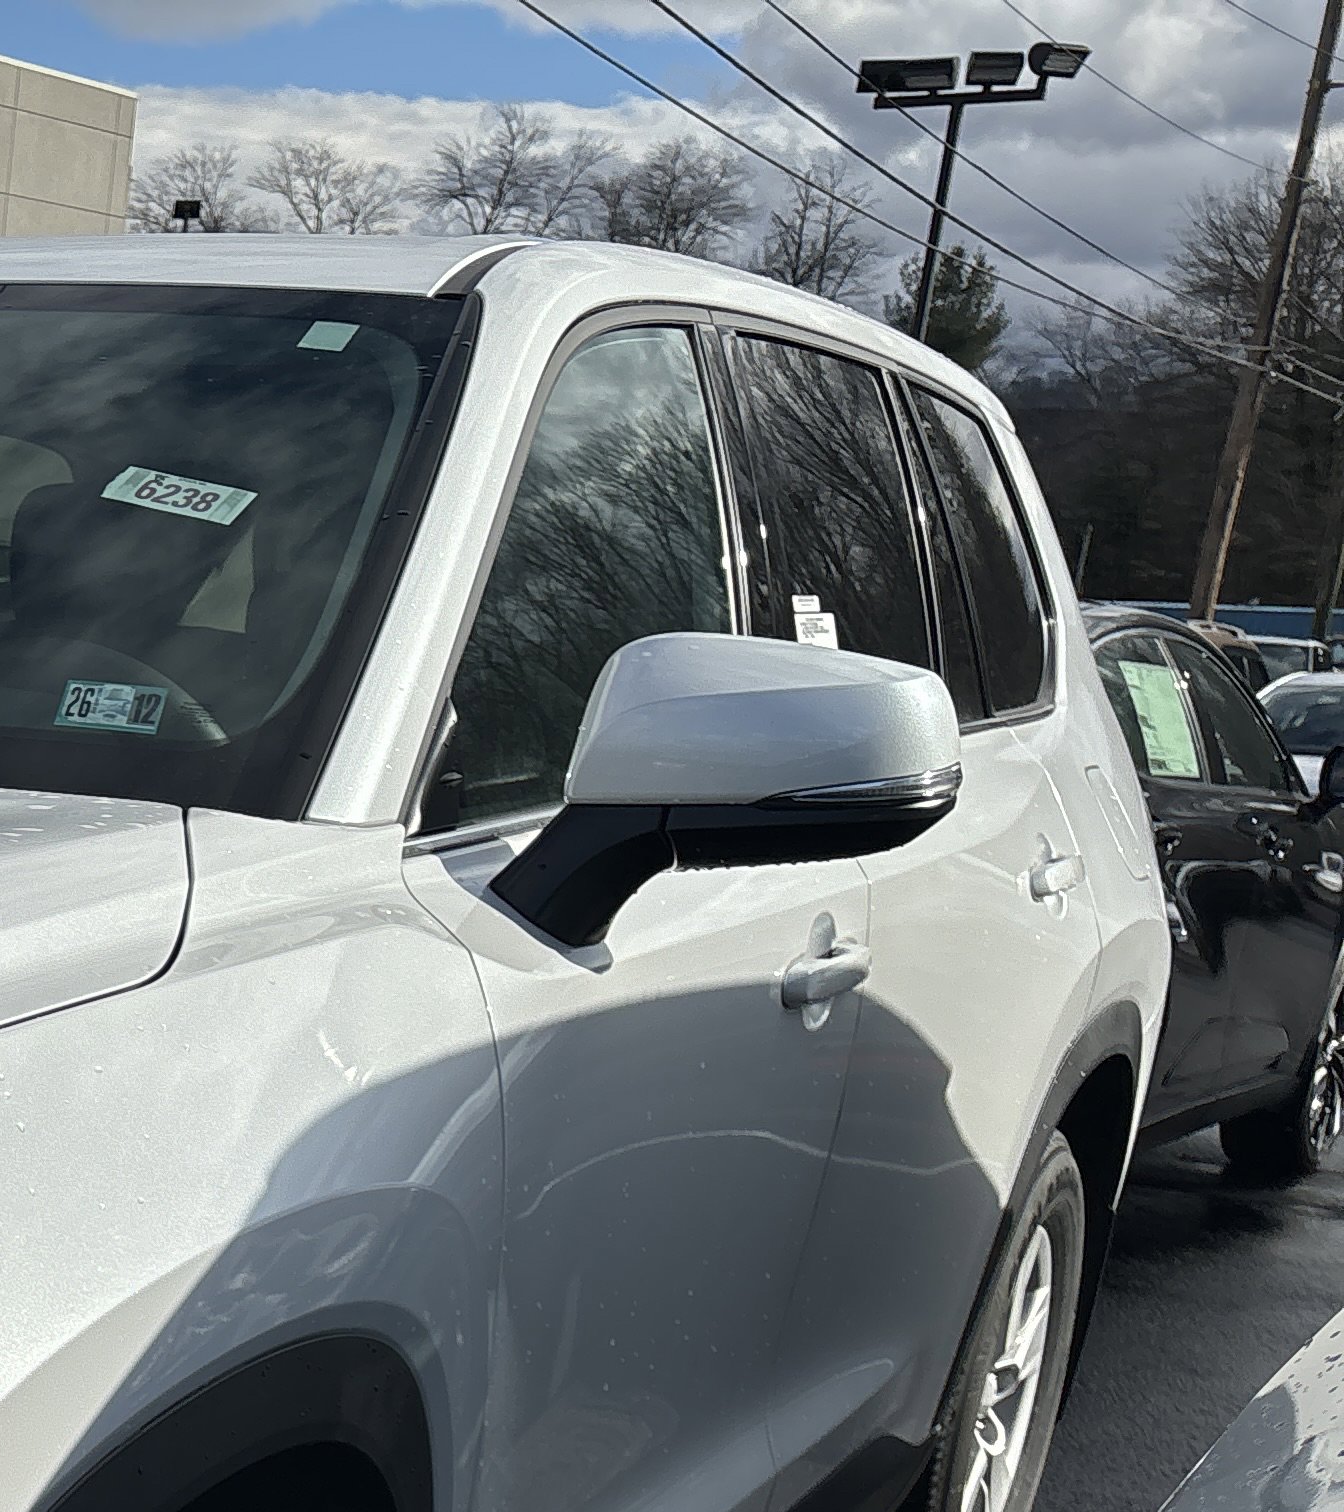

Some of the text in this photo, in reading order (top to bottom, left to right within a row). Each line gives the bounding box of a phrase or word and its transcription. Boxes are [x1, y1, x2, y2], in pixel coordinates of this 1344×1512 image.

[134, 479, 220, 513] 6238
[64, 686, 95, 718] 26
[132, 693, 161, 724] 12
